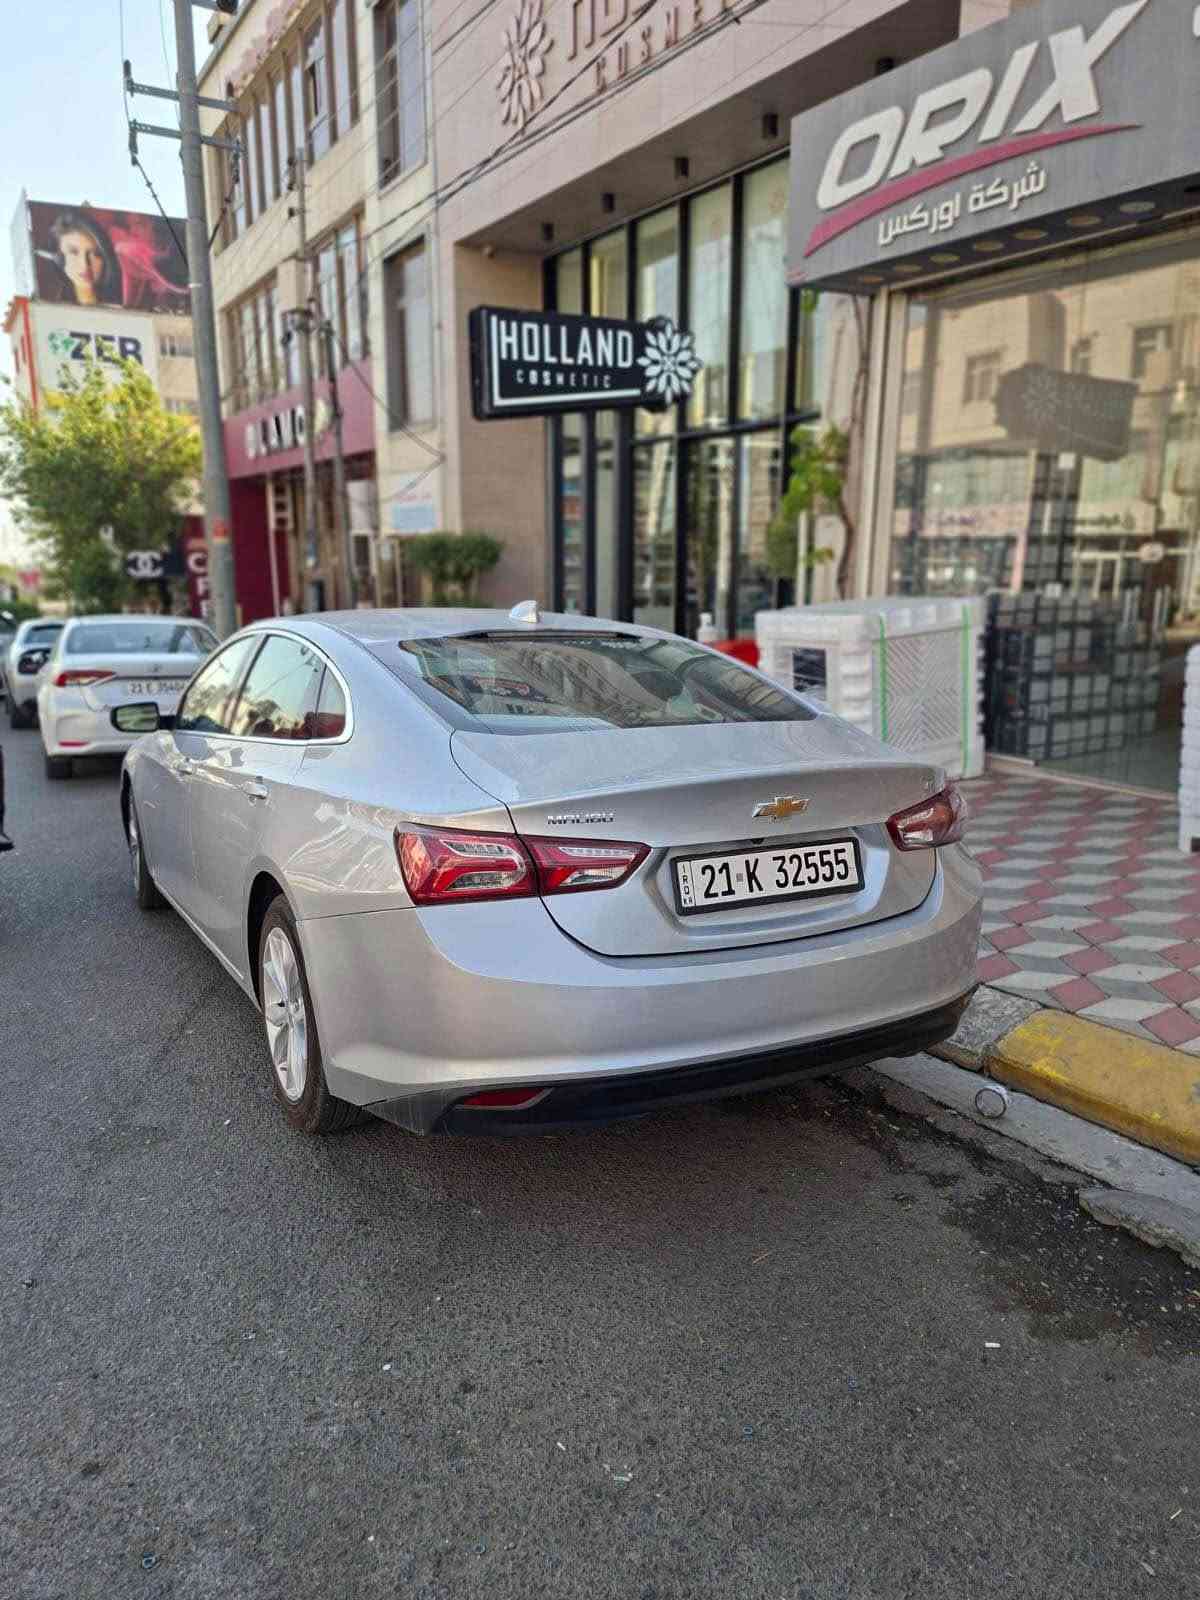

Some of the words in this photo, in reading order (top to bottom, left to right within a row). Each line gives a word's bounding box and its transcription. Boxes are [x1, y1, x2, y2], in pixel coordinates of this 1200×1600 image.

[816, 0, 1147, 210] ORIX
[968, 160, 1047, 212] شركة
[877, 193, 961, 246] اوركس
[69, 331, 144, 366] ZER
[500, 319, 634, 368] HOLLAND
[515, 369, 612, 389] COSMETIC
[701, 861, 736, 899] 21
[745, 857, 764, 893] K
[772, 848, 849, 889] 32555
